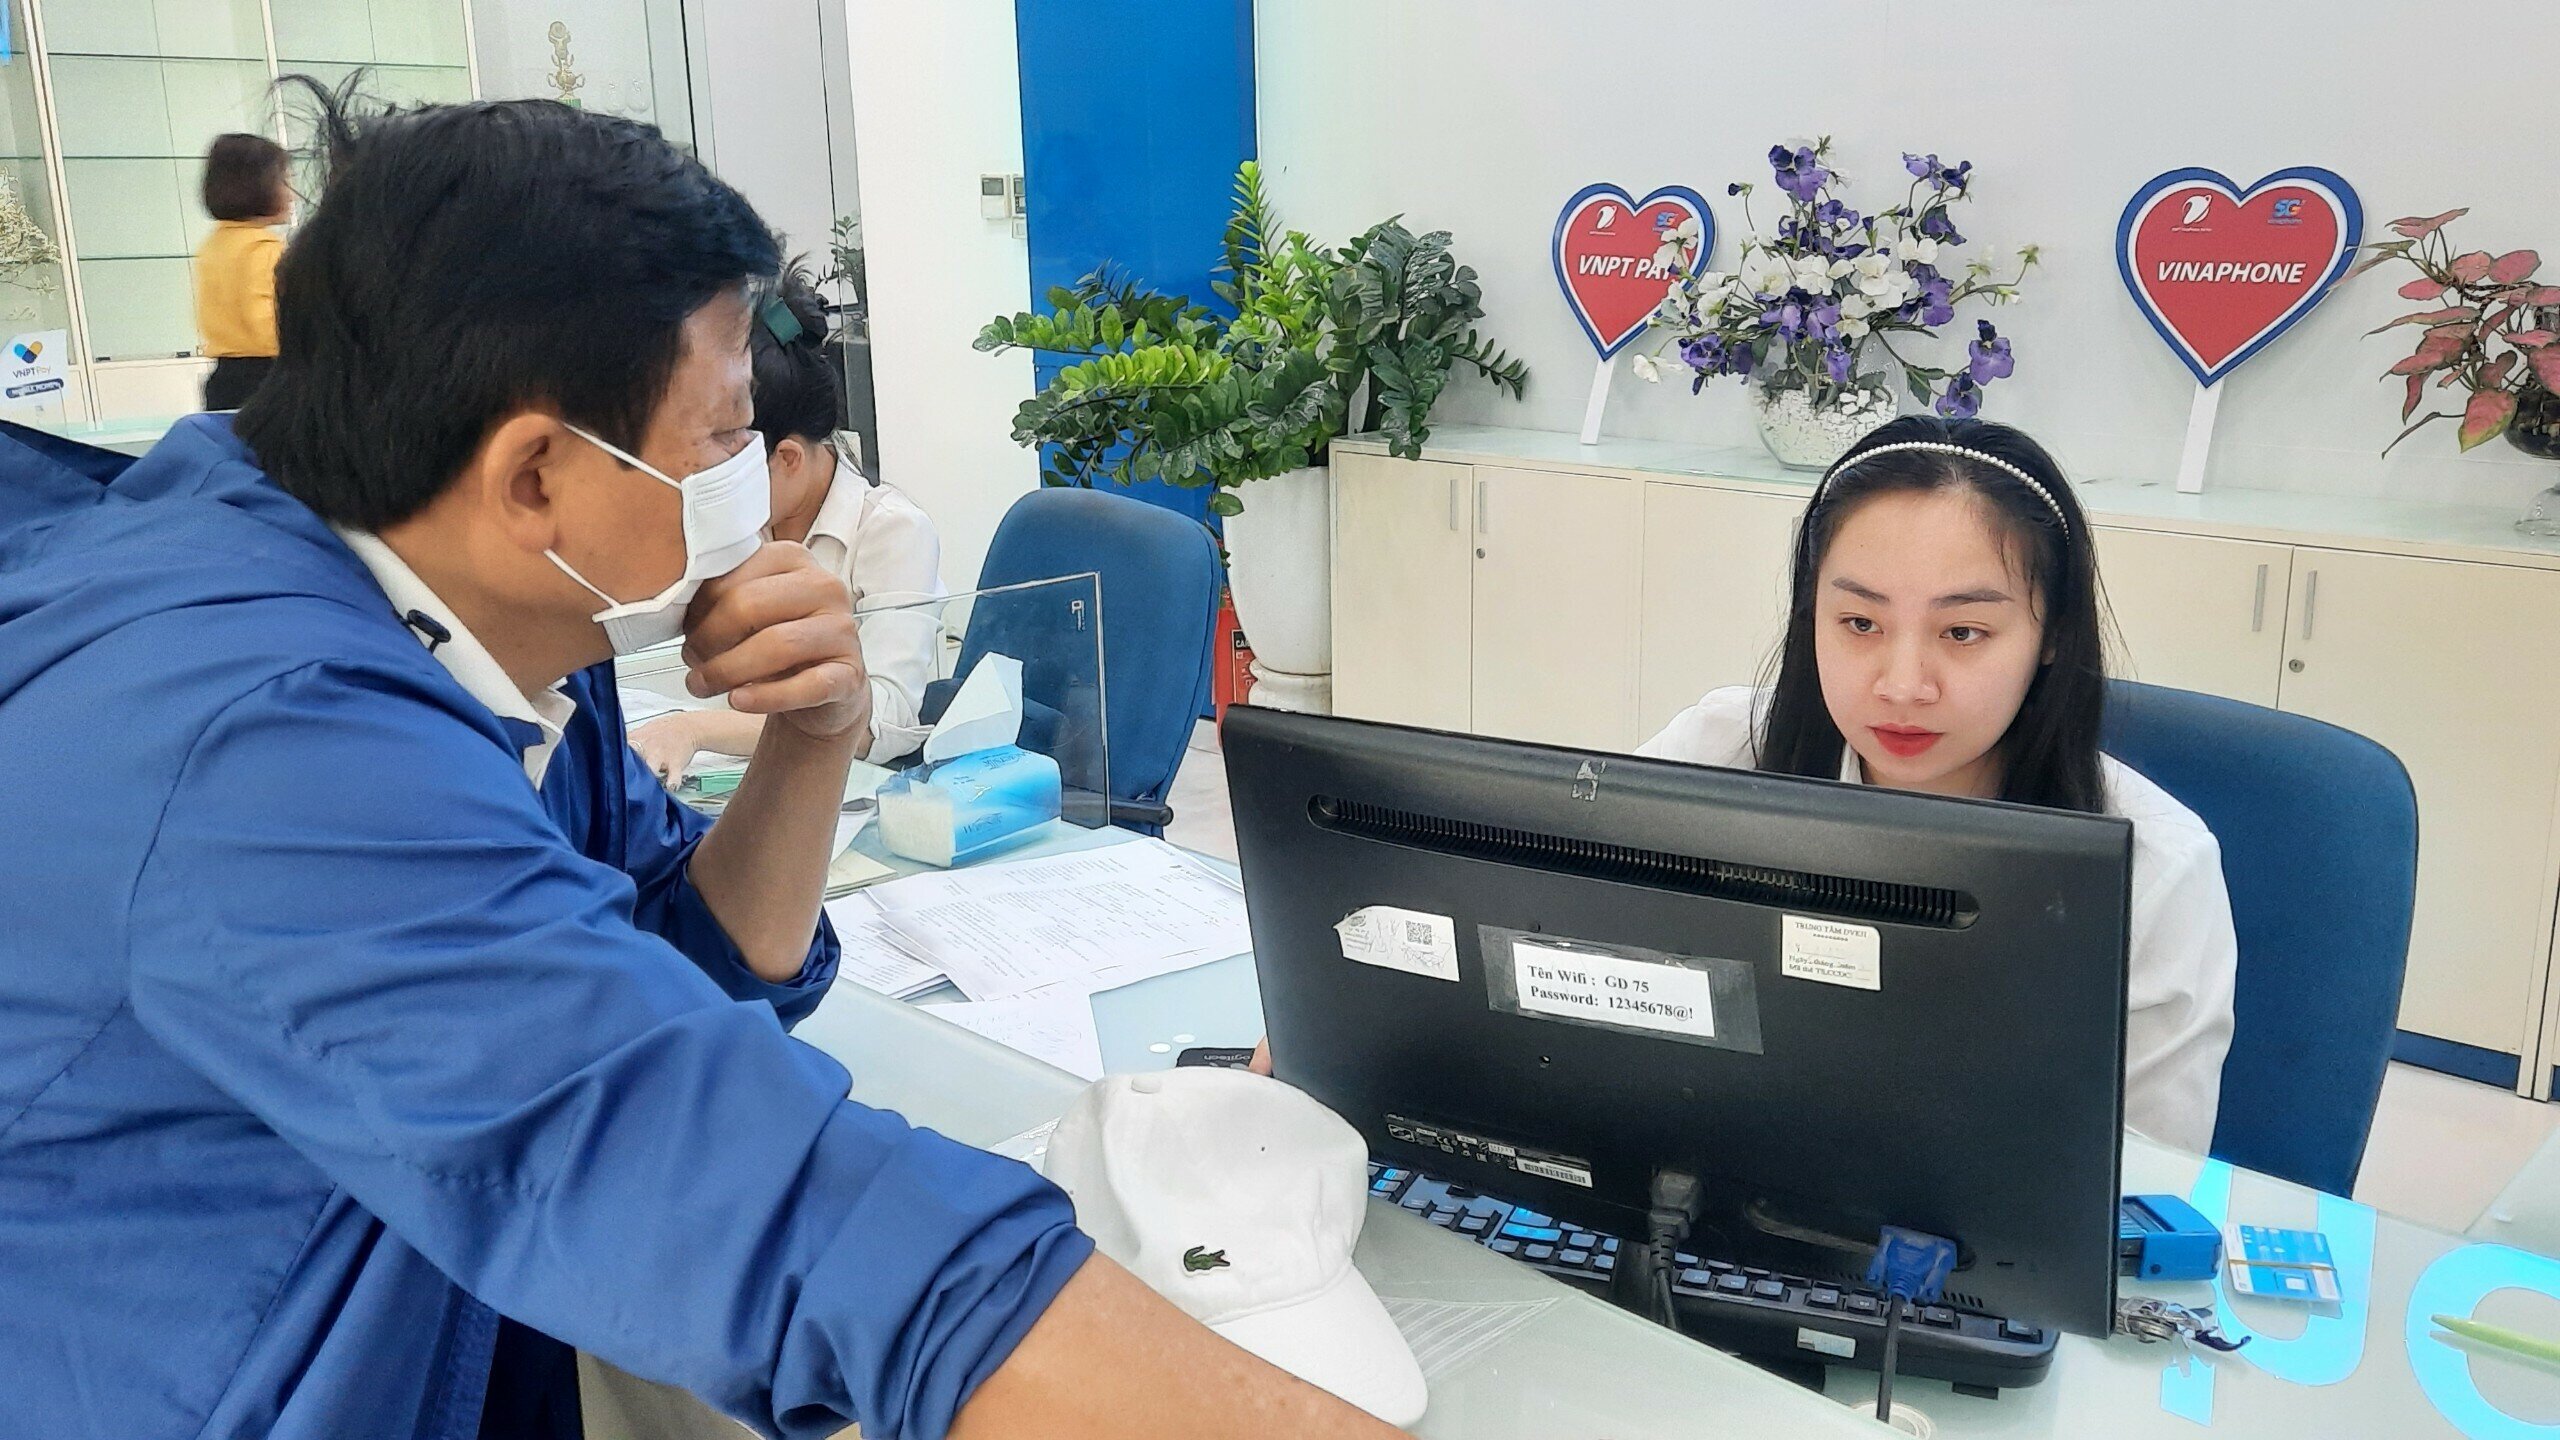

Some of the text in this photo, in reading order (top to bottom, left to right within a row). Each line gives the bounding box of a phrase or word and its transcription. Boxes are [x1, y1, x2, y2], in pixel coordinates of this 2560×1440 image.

[1579, 254, 1635, 277] VNPT
[2158, 261, 2306, 284] VINAPHONE
[1527, 965, 1553, 980] Tên
[1557, 969, 1587, 985] Wifi
[1605, 975, 1628, 990] GD
[1632, 980, 1649, 993] 75
[1531, 985, 1693, 1022] Password: 12345678@!
[1203, 1053, 1252, 1062] ogitech
